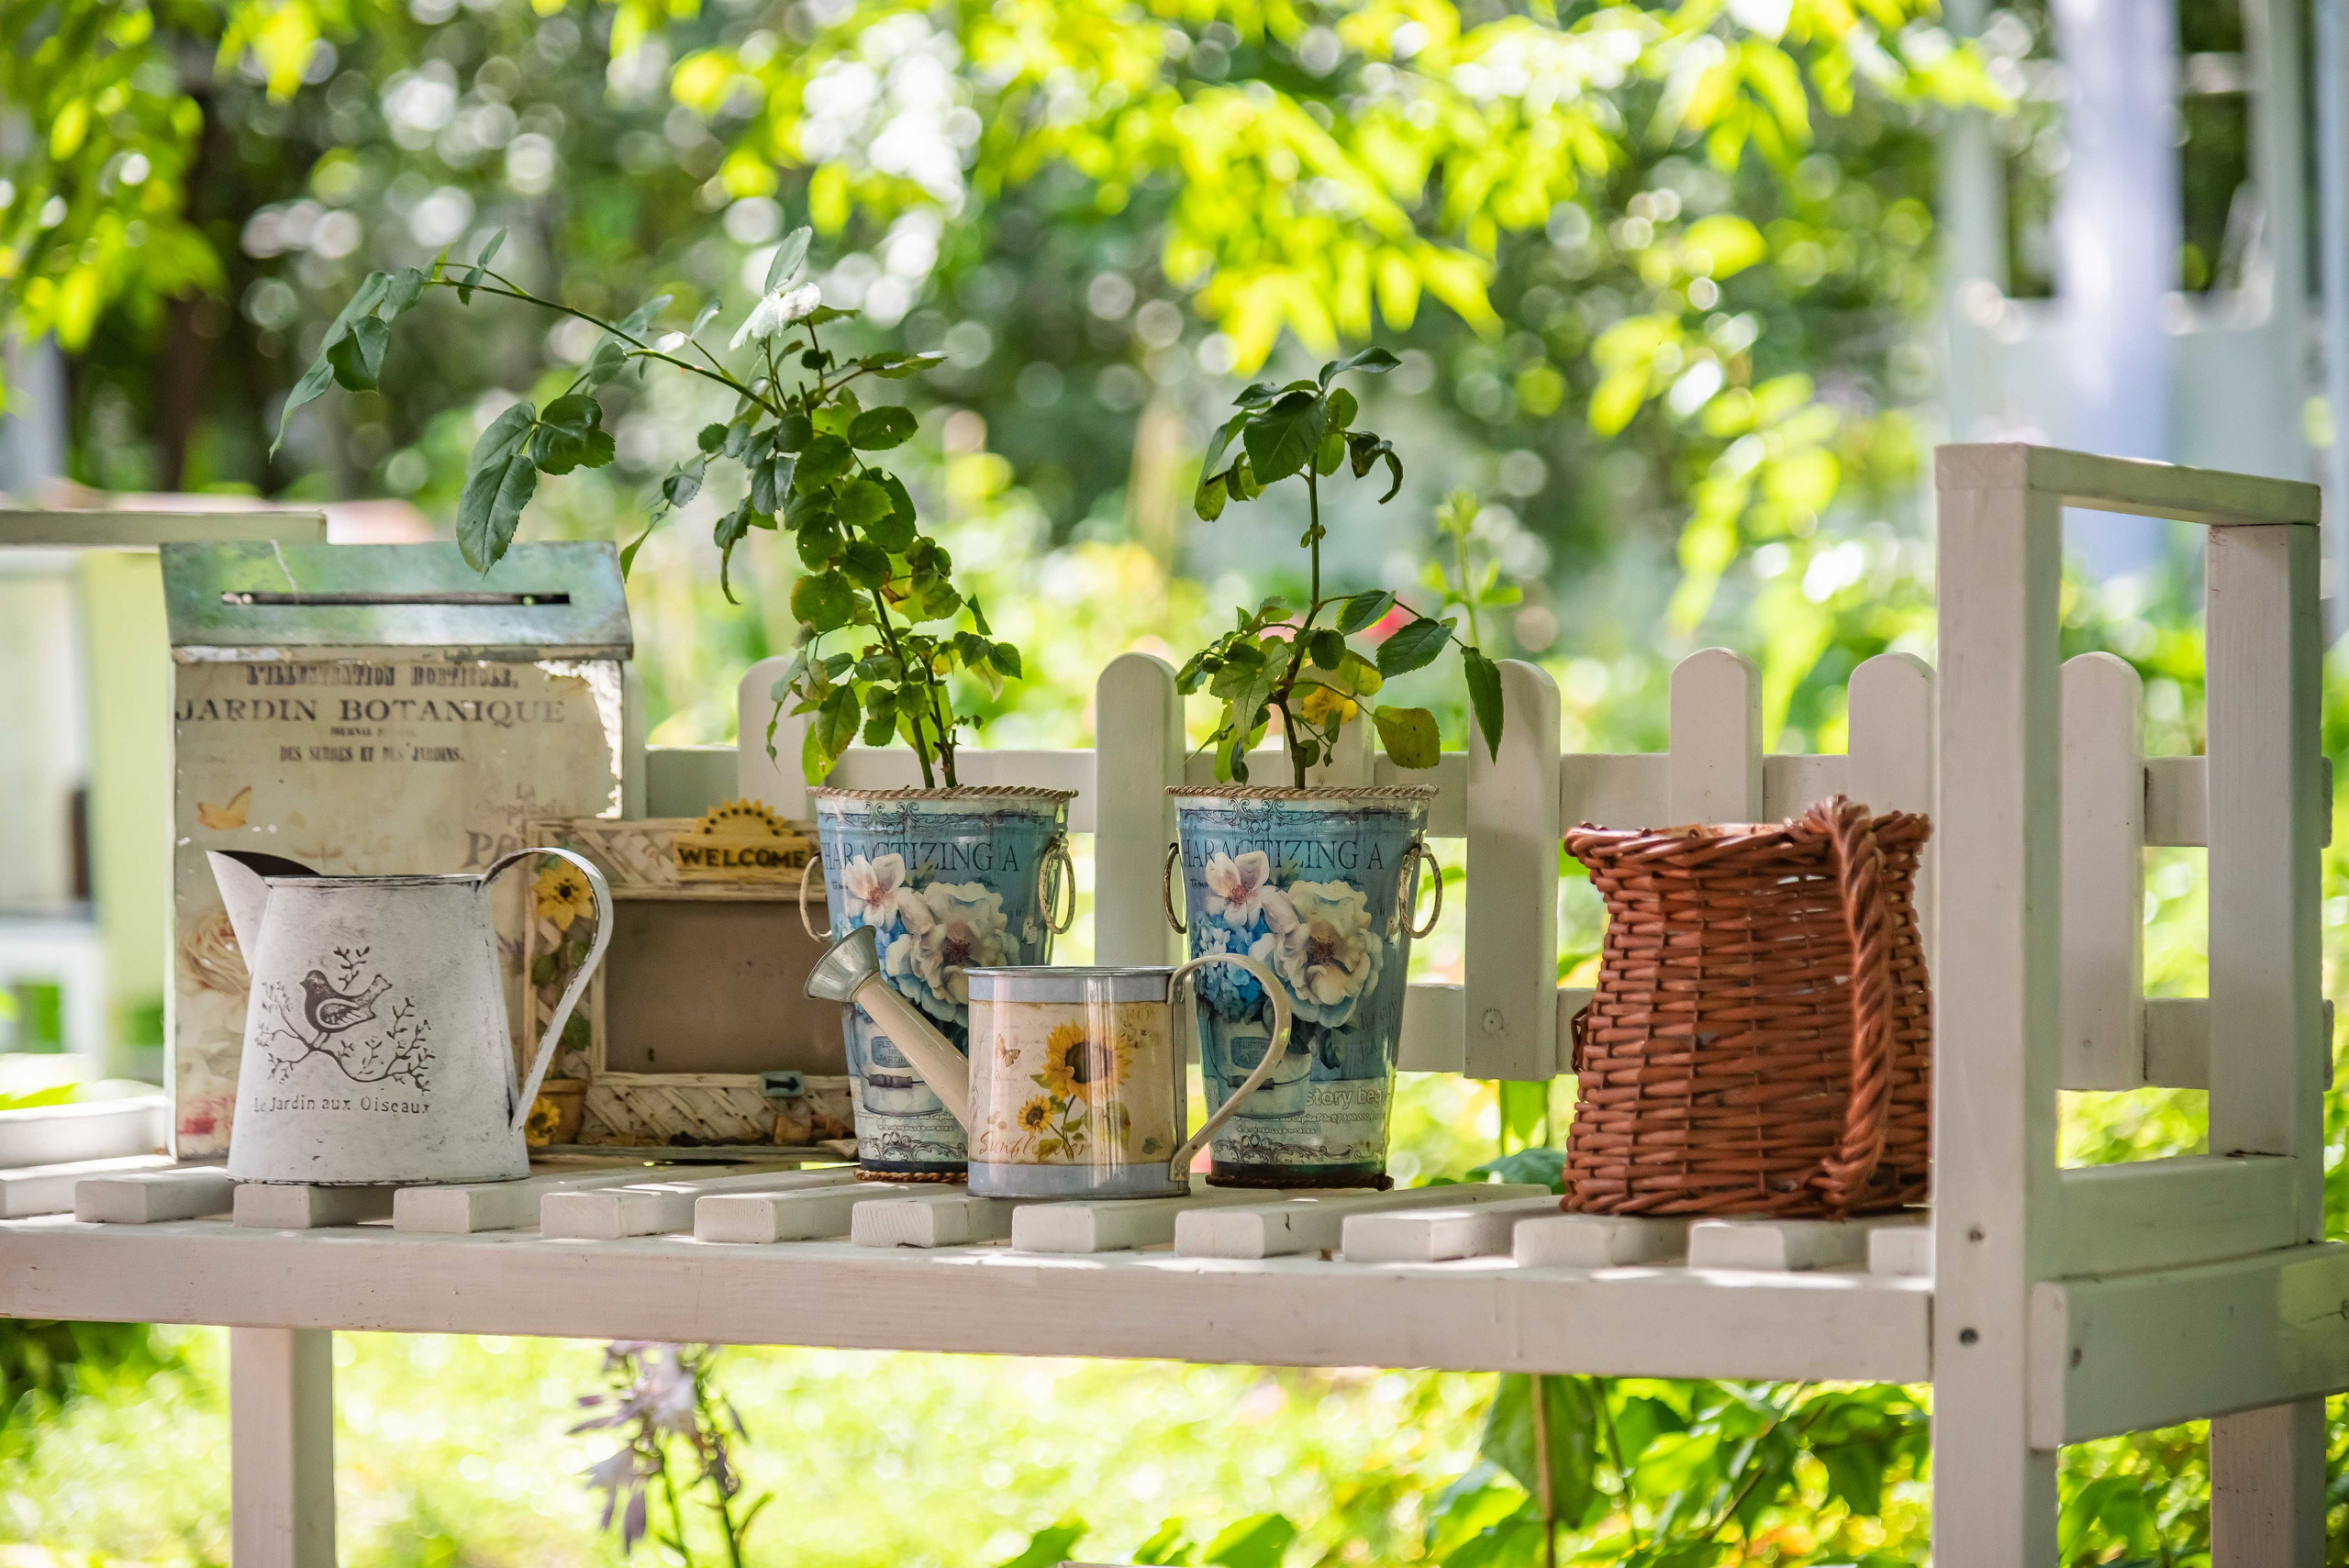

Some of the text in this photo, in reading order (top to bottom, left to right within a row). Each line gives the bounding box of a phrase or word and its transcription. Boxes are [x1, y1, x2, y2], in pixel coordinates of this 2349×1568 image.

[175, 698, 565, 728] JARDIN BOTANIQUE
[677, 848, 806, 869] WELCOME
[1001, 842, 1020, 872] A
[1367, 841, 1385, 870] A
[254, 1095, 429, 1114] Le Jardin aux Oiseaux
[1307, 1087, 1353, 1110] story
